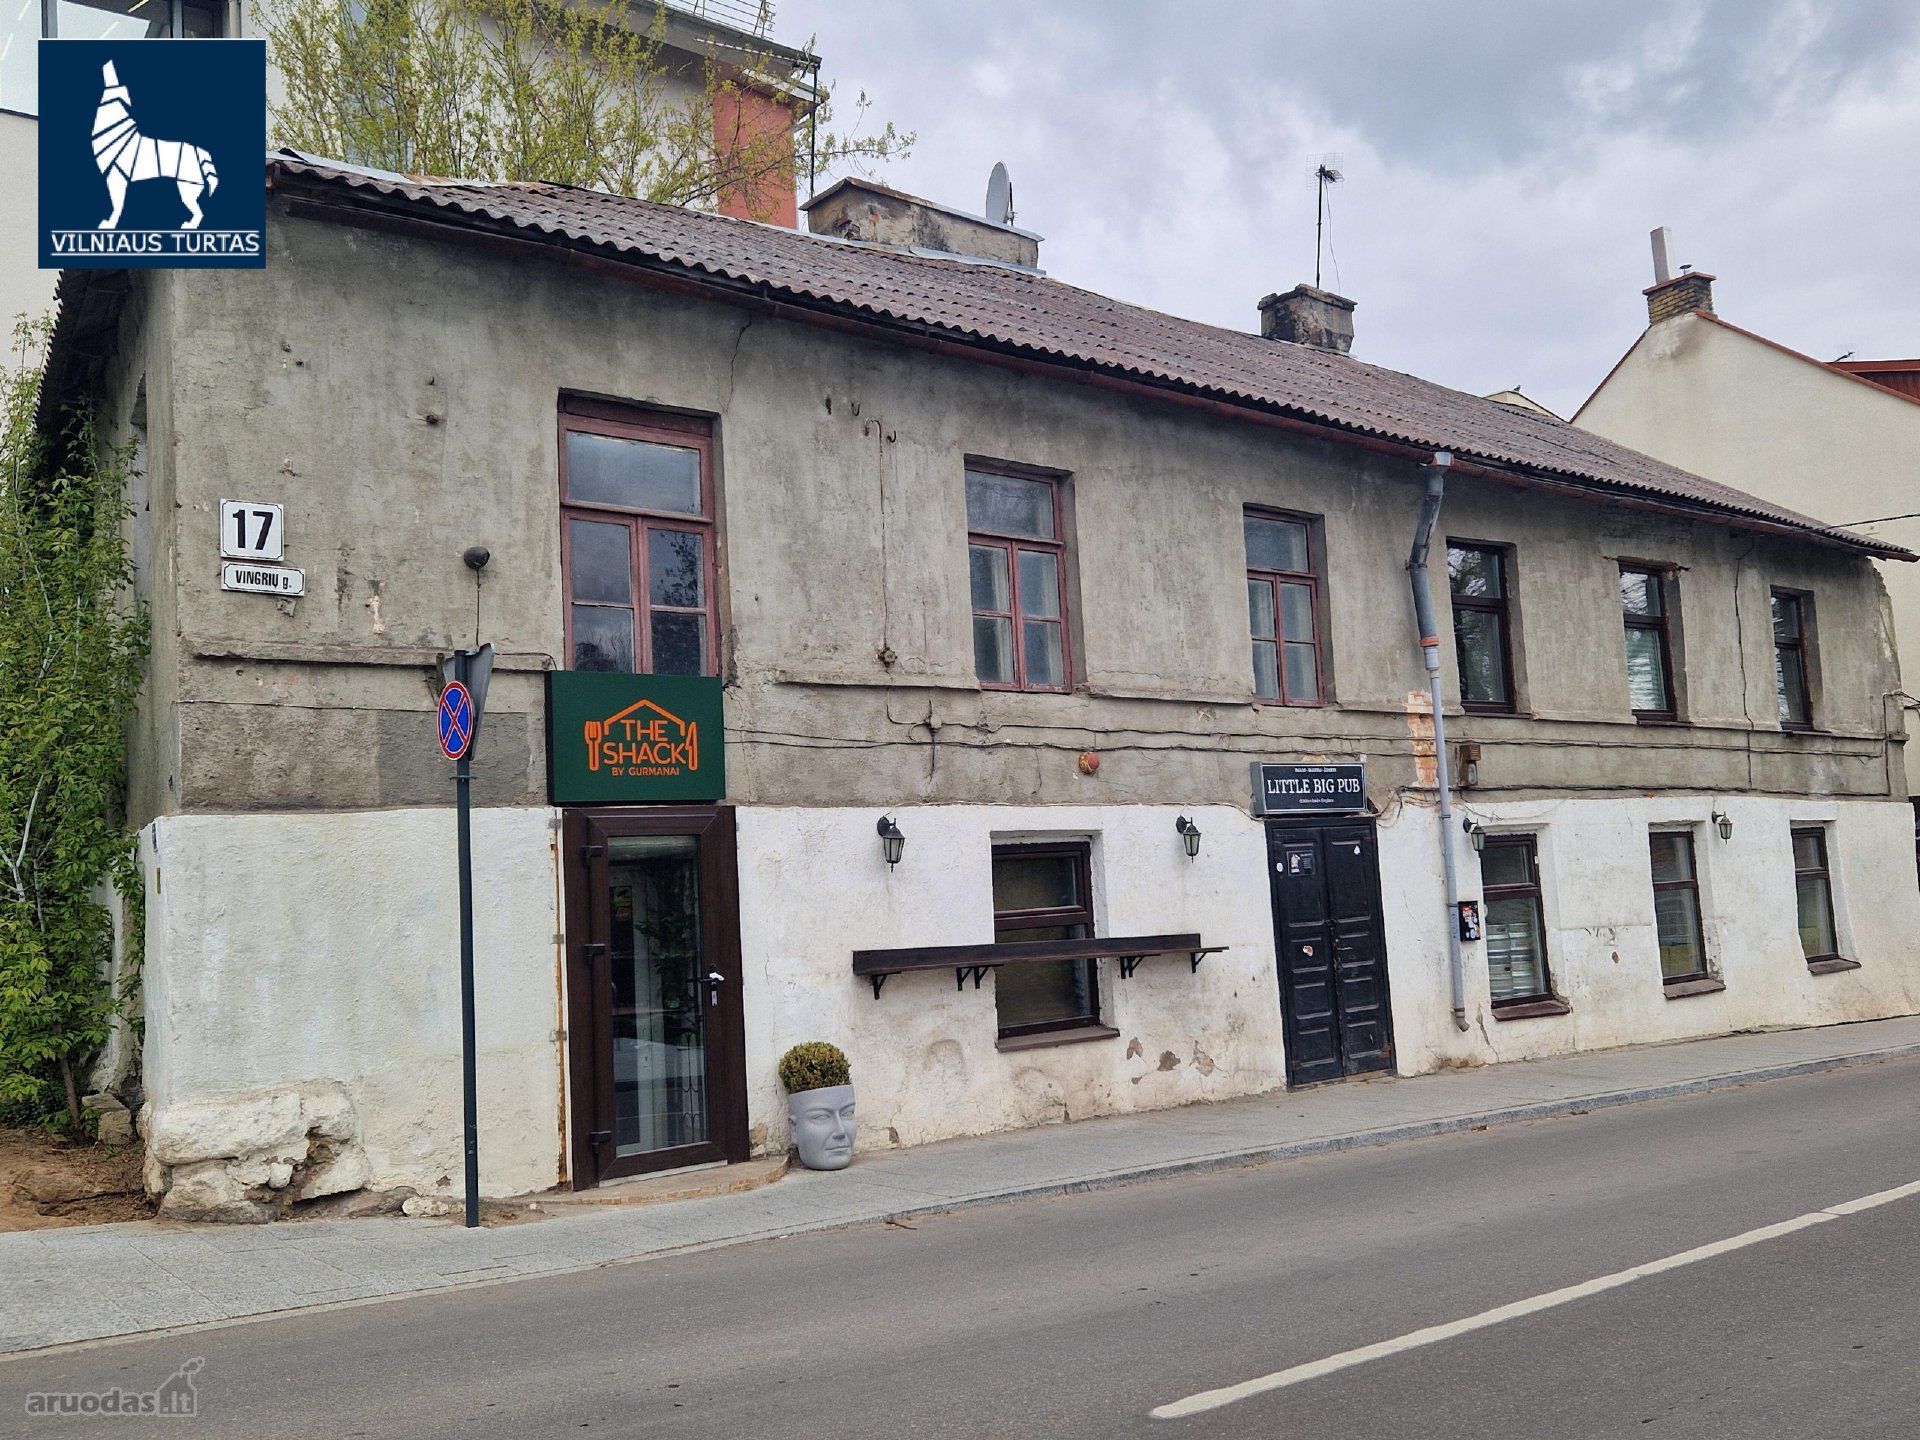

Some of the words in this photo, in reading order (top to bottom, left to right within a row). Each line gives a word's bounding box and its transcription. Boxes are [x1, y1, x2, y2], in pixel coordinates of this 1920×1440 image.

[232, 509, 274, 551] 17
[235, 569, 279, 588] VINGRIŲ
[282, 577, 293, 590] g.
[619, 719, 669, 742] THE
[603, 742, 687, 765] SHACK
[611, 766, 625, 776] BY
[628, 766, 680, 776] GURMANAI
[1267, 779, 1311, 794] LITTLE
[1313, 779, 1335, 793] BIG
[1337, 778, 1361, 793] PUB
